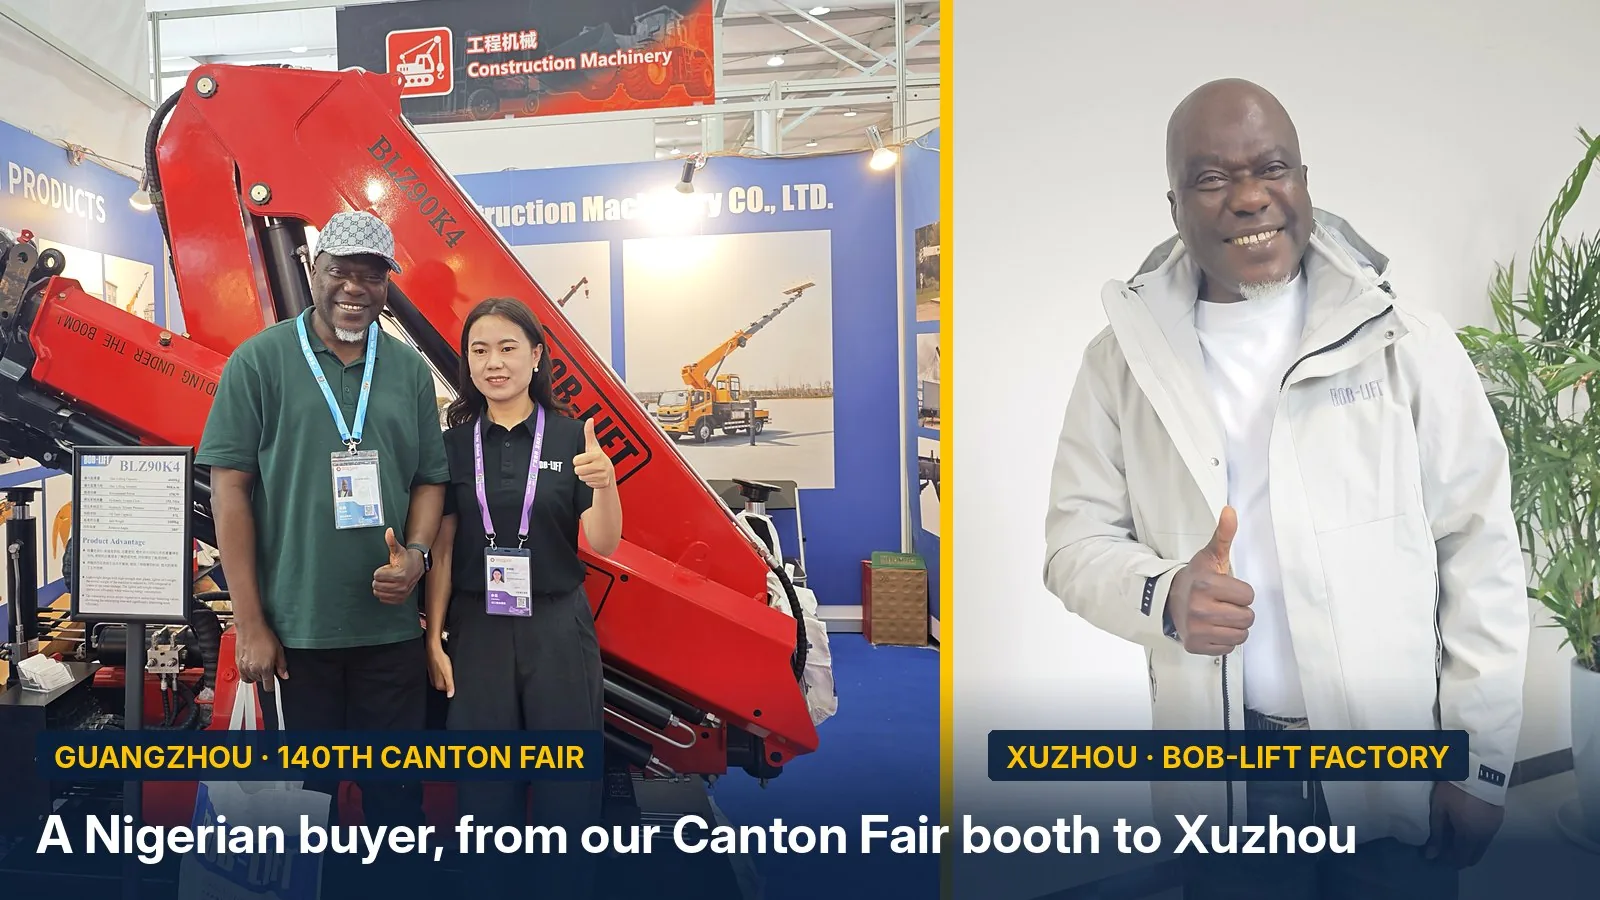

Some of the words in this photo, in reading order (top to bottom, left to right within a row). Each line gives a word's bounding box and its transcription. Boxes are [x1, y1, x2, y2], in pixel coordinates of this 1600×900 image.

[466, 31, 538, 53] 工程机械
[467, 55, 576, 77] Construction
[580, 49, 673, 68] Machinery
[8, 161, 106, 223] PRODUCTS
[367, 134, 466, 248] BLZ90K4
[728, 186, 776, 215] CO.,
[782, 184, 834, 211] LTD.
[58, 315, 98, 340] BOOM!
[102, 333, 127, 355] THE
[133, 348, 176, 377] UNDER
[120, 460, 180, 473] BLZ90K4
[82, 537, 108, 545] Product
[110, 538, 145, 547] Advantage
